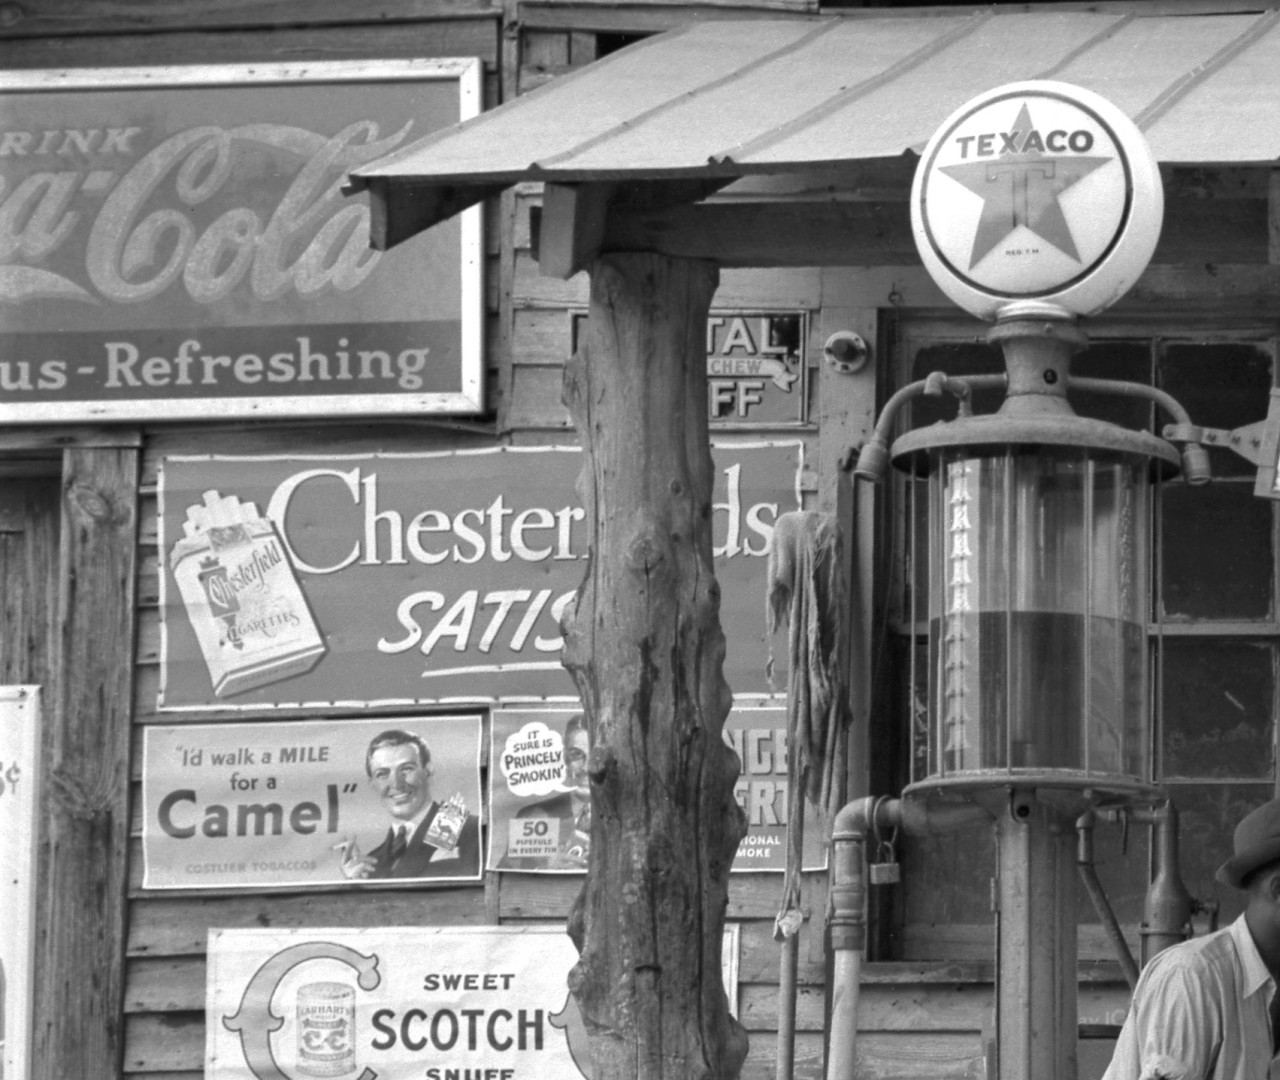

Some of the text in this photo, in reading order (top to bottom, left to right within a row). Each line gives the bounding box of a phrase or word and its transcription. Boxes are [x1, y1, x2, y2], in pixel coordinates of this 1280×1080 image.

[0, 127, 142, 156] RINK
[955, 130, 1094, 159] TEXACO
[0, 118, 414, 302] a-Cola
[710, 362, 762, 374] CHEW
[267, 468, 778, 573] Chesterds
[527, 730, 540, 740] IT
[512, 739, 554, 753] SURE IS
[211, 748, 256, 767] walk
[260, 752, 272, 765] a
[279, 746, 330, 764] MILE
[504, 750, 562, 770] PRINCELY
[229, 772, 278, 791] for a
[522, 820, 549, 837] 50
[509, 848, 519, 856] IN
[520, 847, 541, 856] EVERY
[185, 860, 318, 875] COSTLIER TOBACCOS
[423, 973, 516, 990] SWEET
[371, 1008, 545, 1051] SCOTCH
